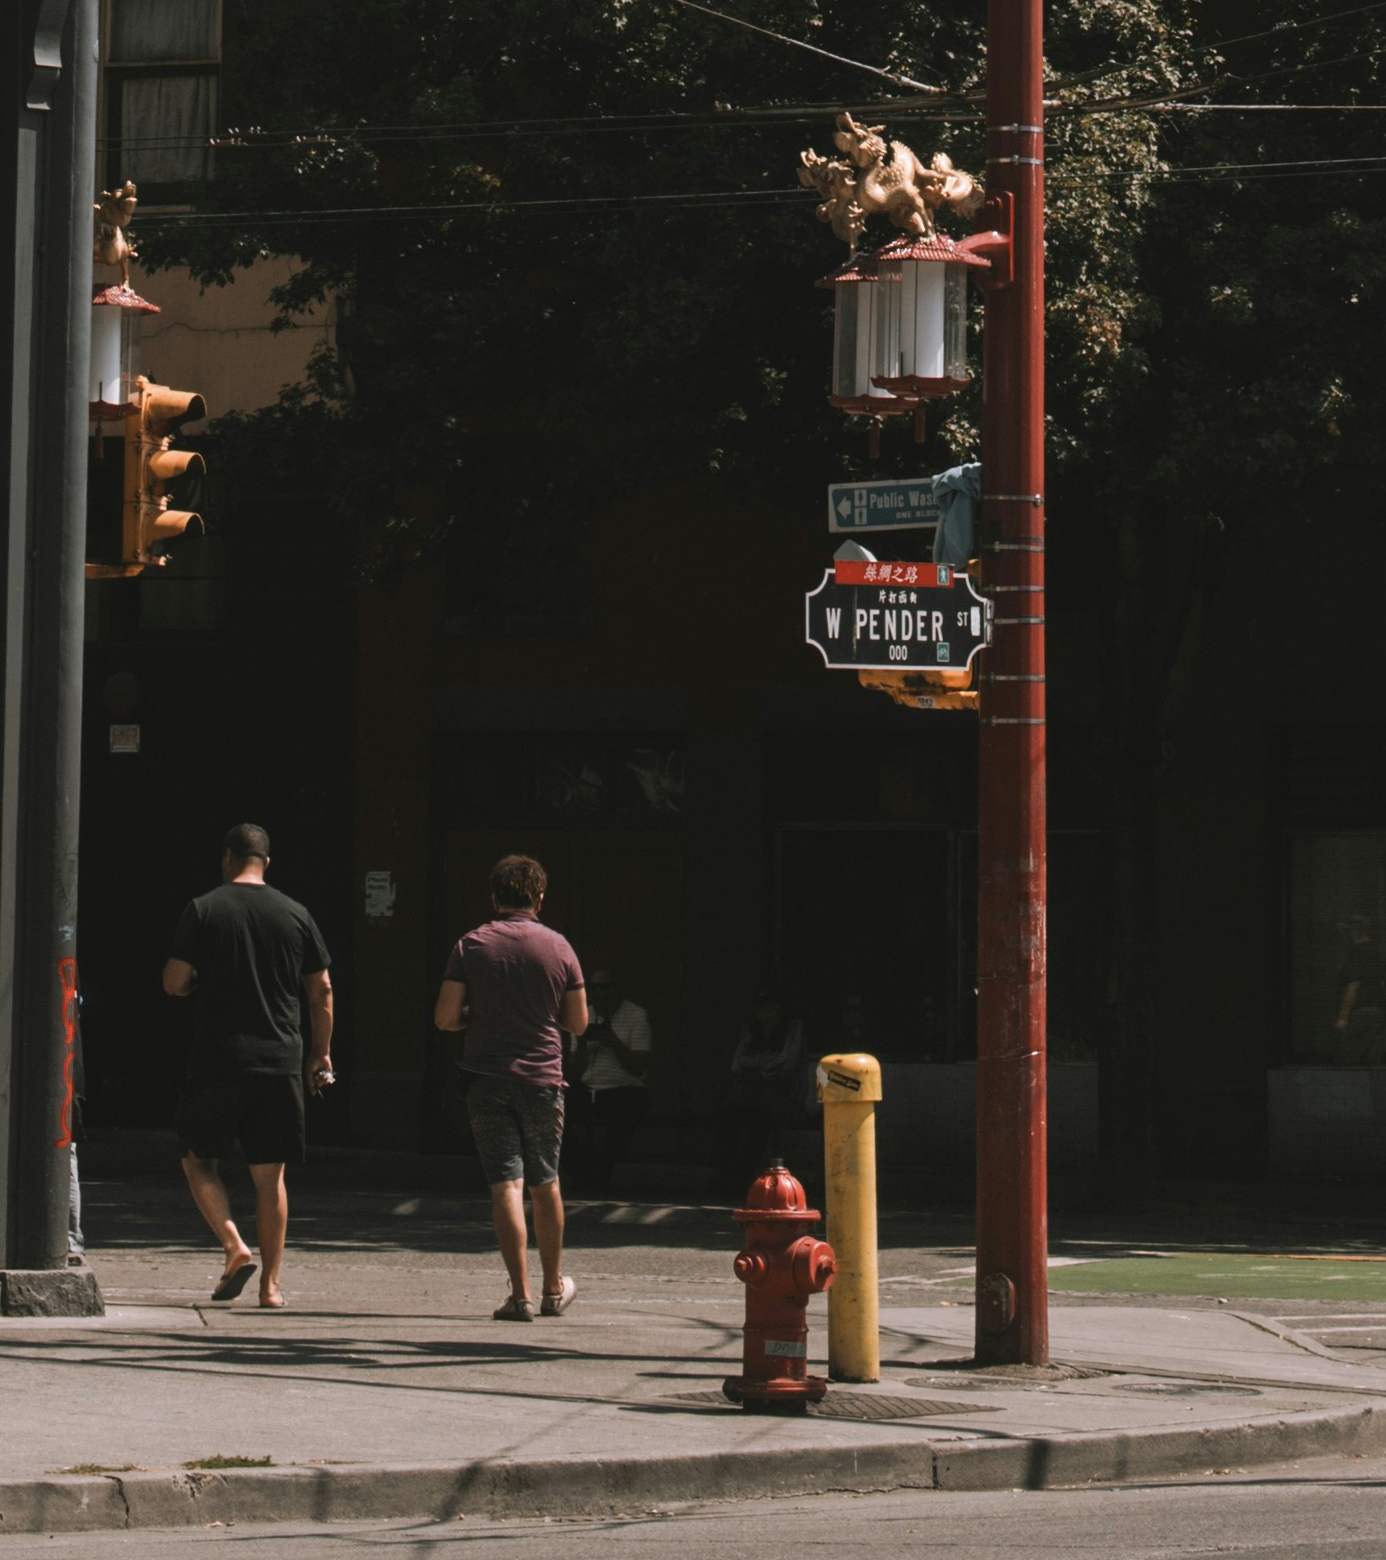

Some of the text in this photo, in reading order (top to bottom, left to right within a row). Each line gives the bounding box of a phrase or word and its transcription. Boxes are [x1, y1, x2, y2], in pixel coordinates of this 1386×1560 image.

[870, 490, 939, 509] Public Was
[826, 608, 969, 642] W PENDER ST
[889, 645, 908, 660] 000
